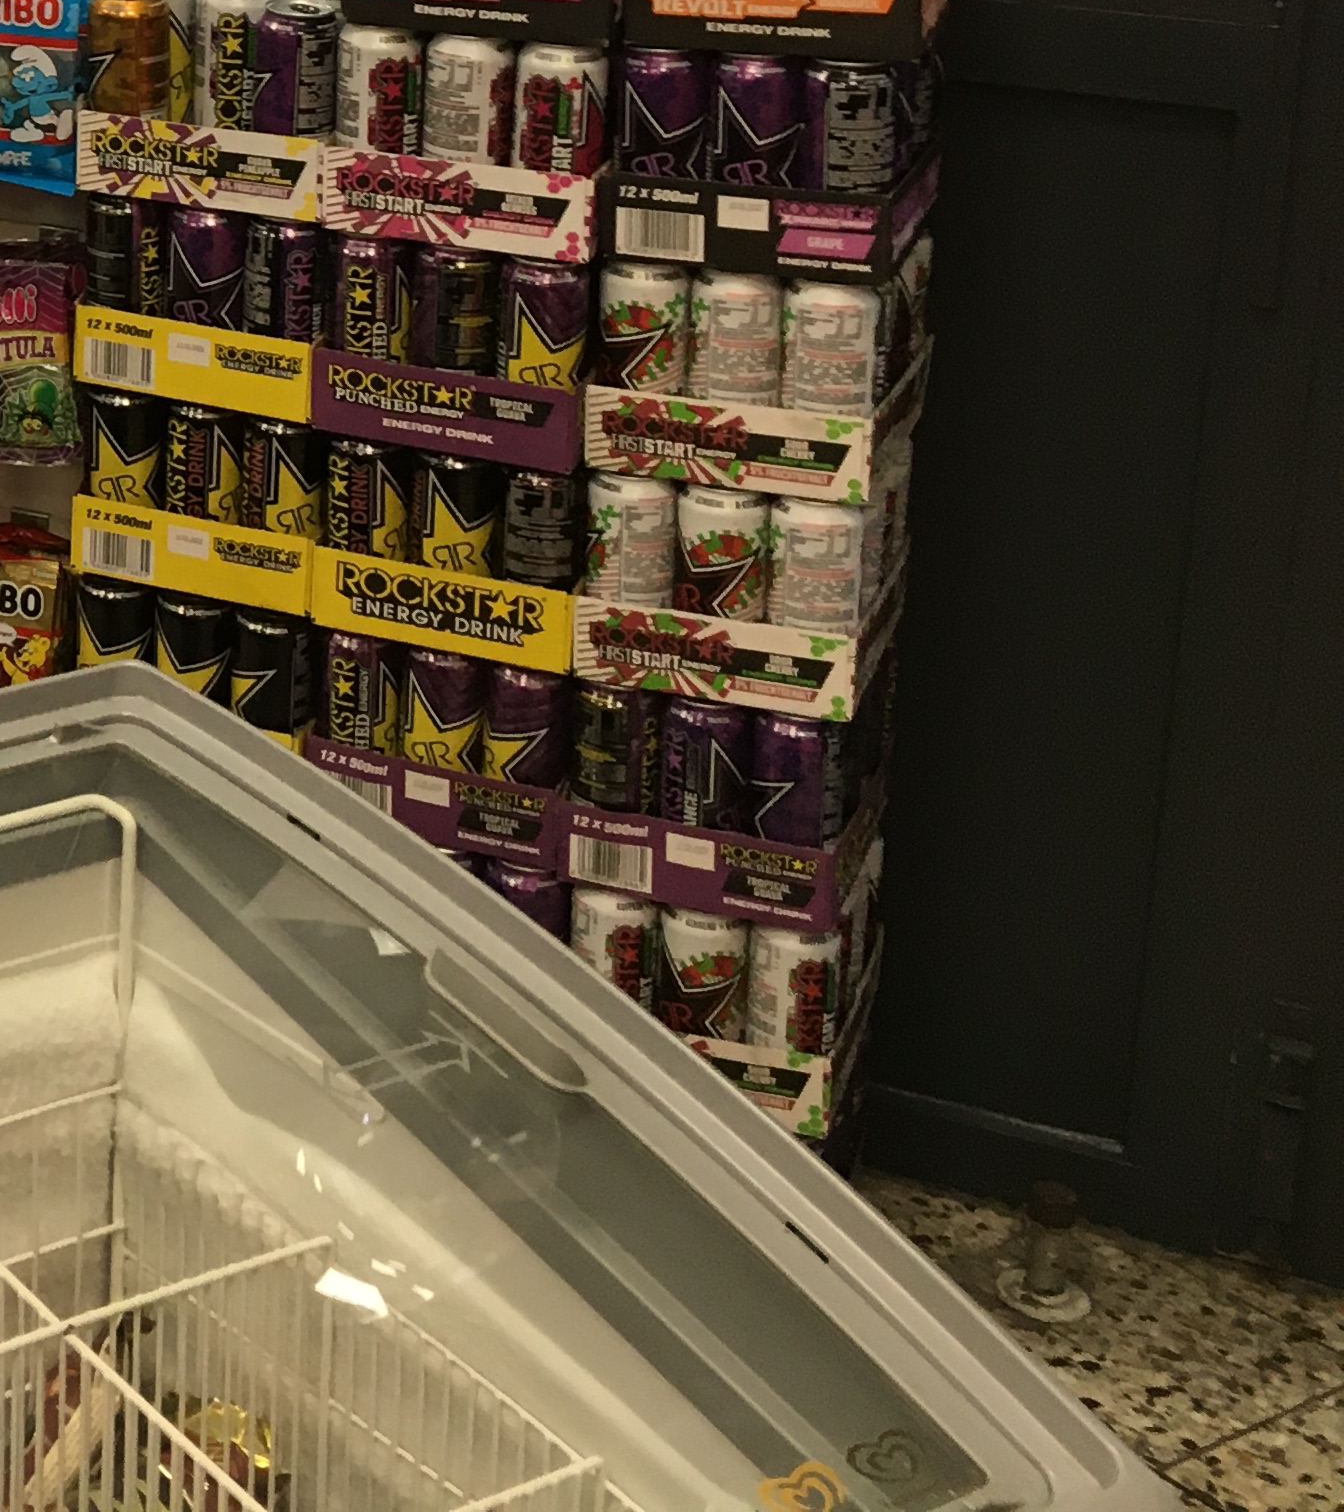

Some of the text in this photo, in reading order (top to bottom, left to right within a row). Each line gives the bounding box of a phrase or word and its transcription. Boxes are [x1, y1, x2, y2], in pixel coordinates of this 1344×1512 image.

[414, 3, 529, 23] ENERGY DRINK
[705, 21, 832, 38] ENERGY DRINK
[618, 185, 699, 205] 12 500ml
[86, 318, 100, 329] 12
[114, 322, 153, 339] 500ml
[214, 344, 303, 372] ROCKSTAR
[221, 360, 294, 380] ENERGY DRINK
[328, 364, 476, 411] ROCKSTAR
[334, 387, 417, 414] PUNCHED
[382, 417, 494, 445] ENERGY DRINK
[86, 507, 101, 519] 12
[112, 513, 154, 531] 500ml
[213, 537, 302, 567] ROCKSTAR
[220, 553, 295, 573] ENERGY DRINK
[336, 561, 547, 632] ROCKSTAR
[352, 596, 524, 646] ENERGY DRINK
[320, 749, 336, 762] 12
[349, 757, 388, 777] 500ml
[573, 814, 590, 828] 12
[604, 821, 649, 838] 500ml
